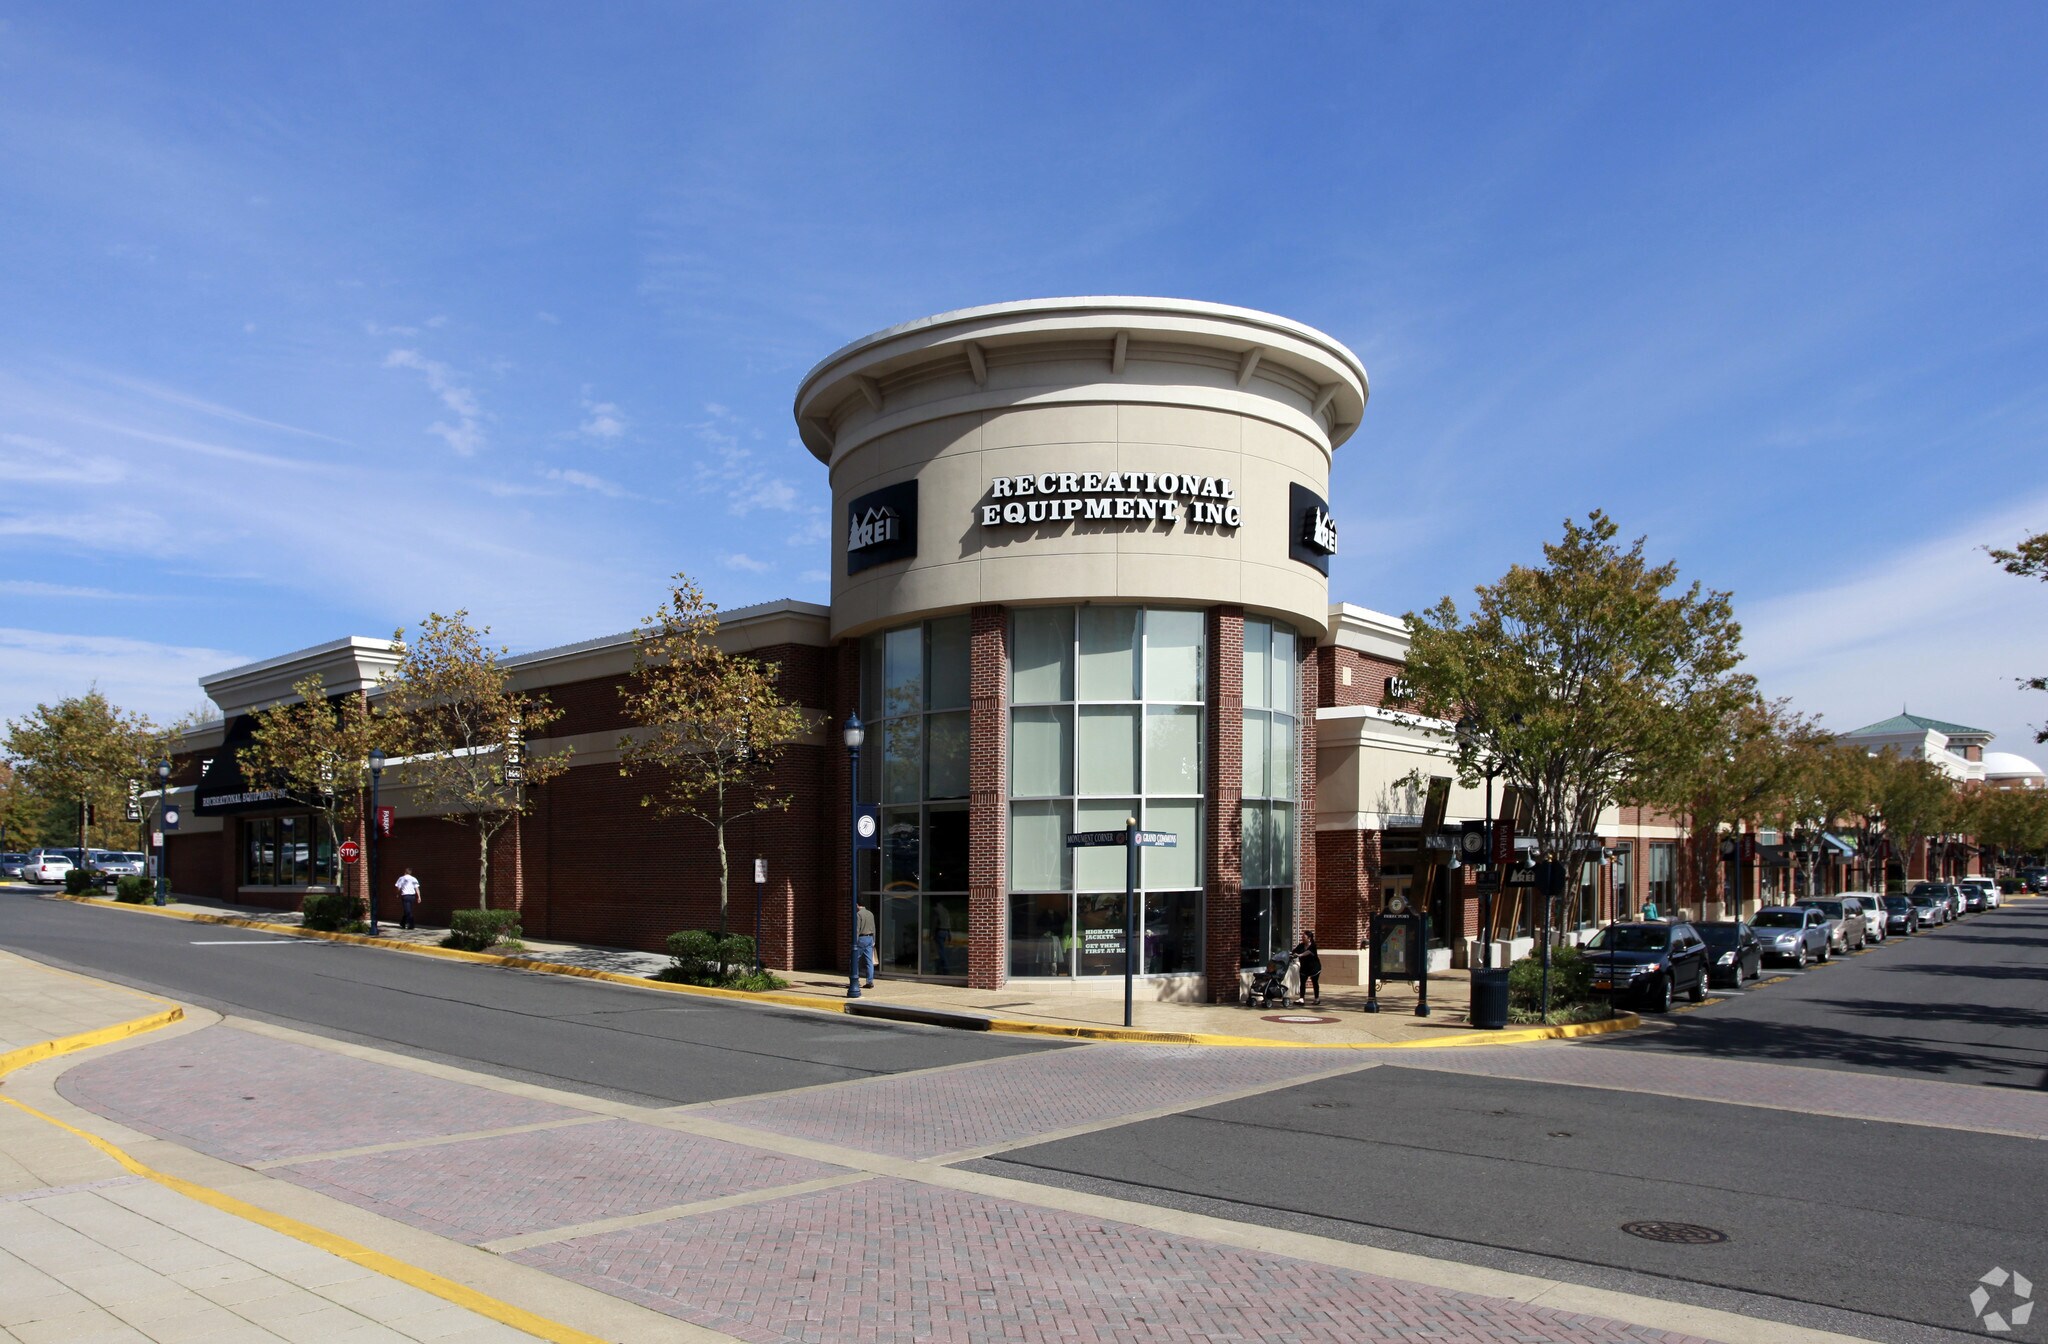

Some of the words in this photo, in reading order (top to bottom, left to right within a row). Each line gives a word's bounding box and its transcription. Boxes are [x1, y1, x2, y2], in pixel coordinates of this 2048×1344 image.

[991, 471, 1236, 499] RECREATIONAL
[981, 498, 1181, 526] EQUIPMENT,
[1193, 502, 1244, 527] INC.
[862, 516, 891, 546] REI
[1067, 834, 1094, 843] MONUMENT
[1094, 833, 1114, 842] CORNER
[1143, 833, 1156, 842] GRAND
[1156, 834, 1177, 843] COMMONS
[1499, 825, 1508, 859] FAIRFAX
[340, 848, 359, 857] STOP
